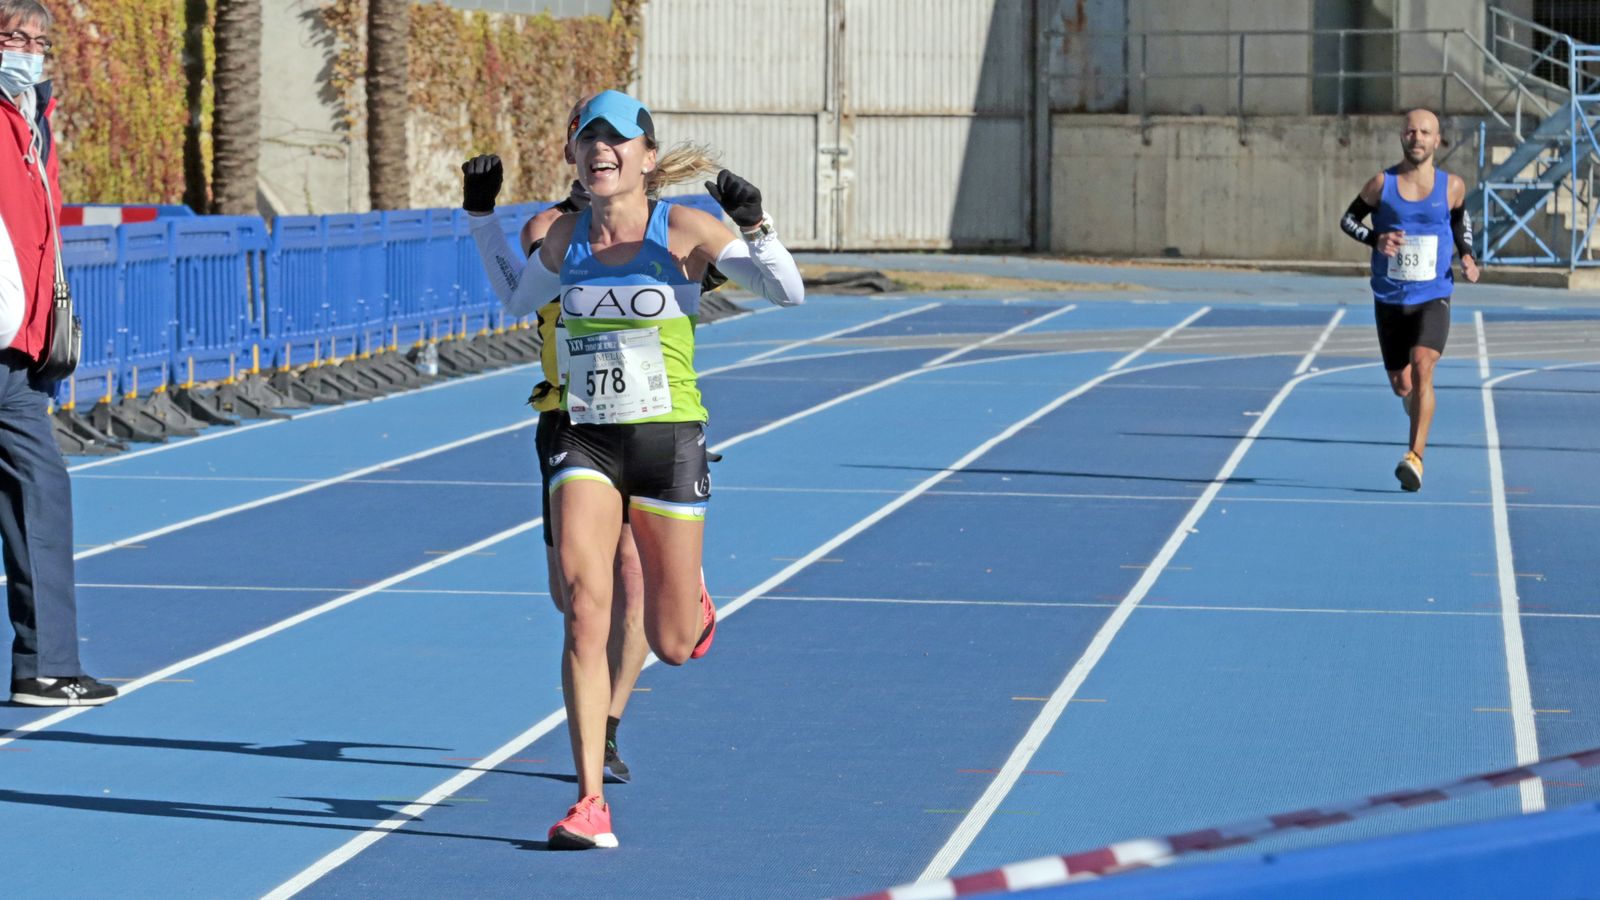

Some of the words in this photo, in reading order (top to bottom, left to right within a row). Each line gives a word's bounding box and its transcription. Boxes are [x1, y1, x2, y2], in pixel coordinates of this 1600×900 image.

[1397, 252, 1419, 266] 853
[562, 286, 666, 318] CAO
[569, 339, 584, 352] XXV
[586, 367, 626, 397] 578
